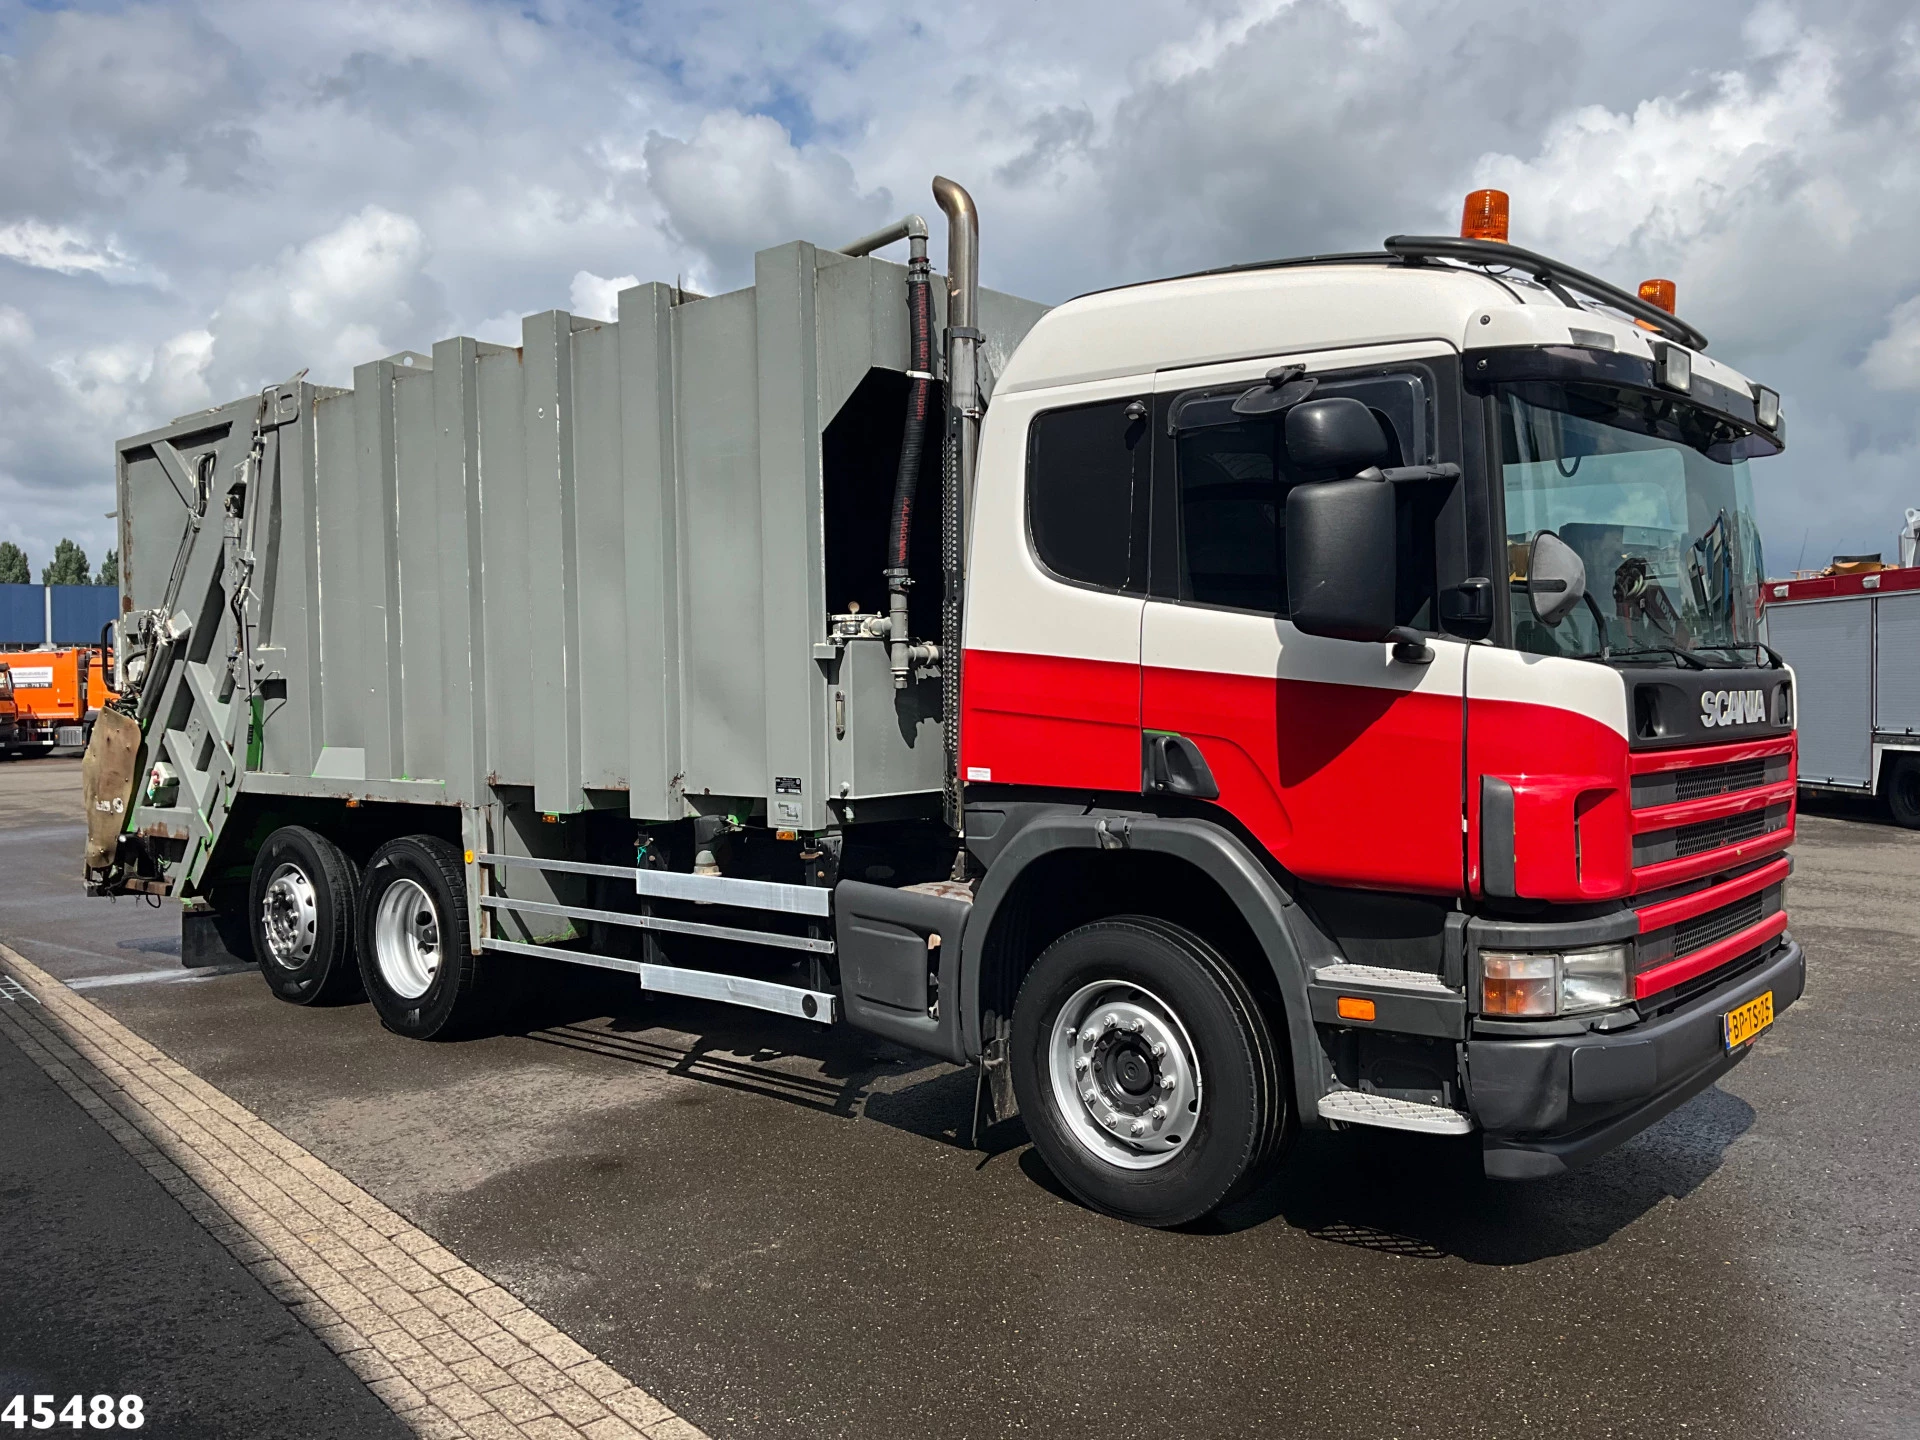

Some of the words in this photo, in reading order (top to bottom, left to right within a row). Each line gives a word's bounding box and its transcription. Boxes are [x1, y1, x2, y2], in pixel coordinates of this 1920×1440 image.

[918, 283, 928, 339] PETROLEUM
[1700, 689, 1766, 728] SCANIA
[1732, 997, 1771, 1040] BP-TS-25
